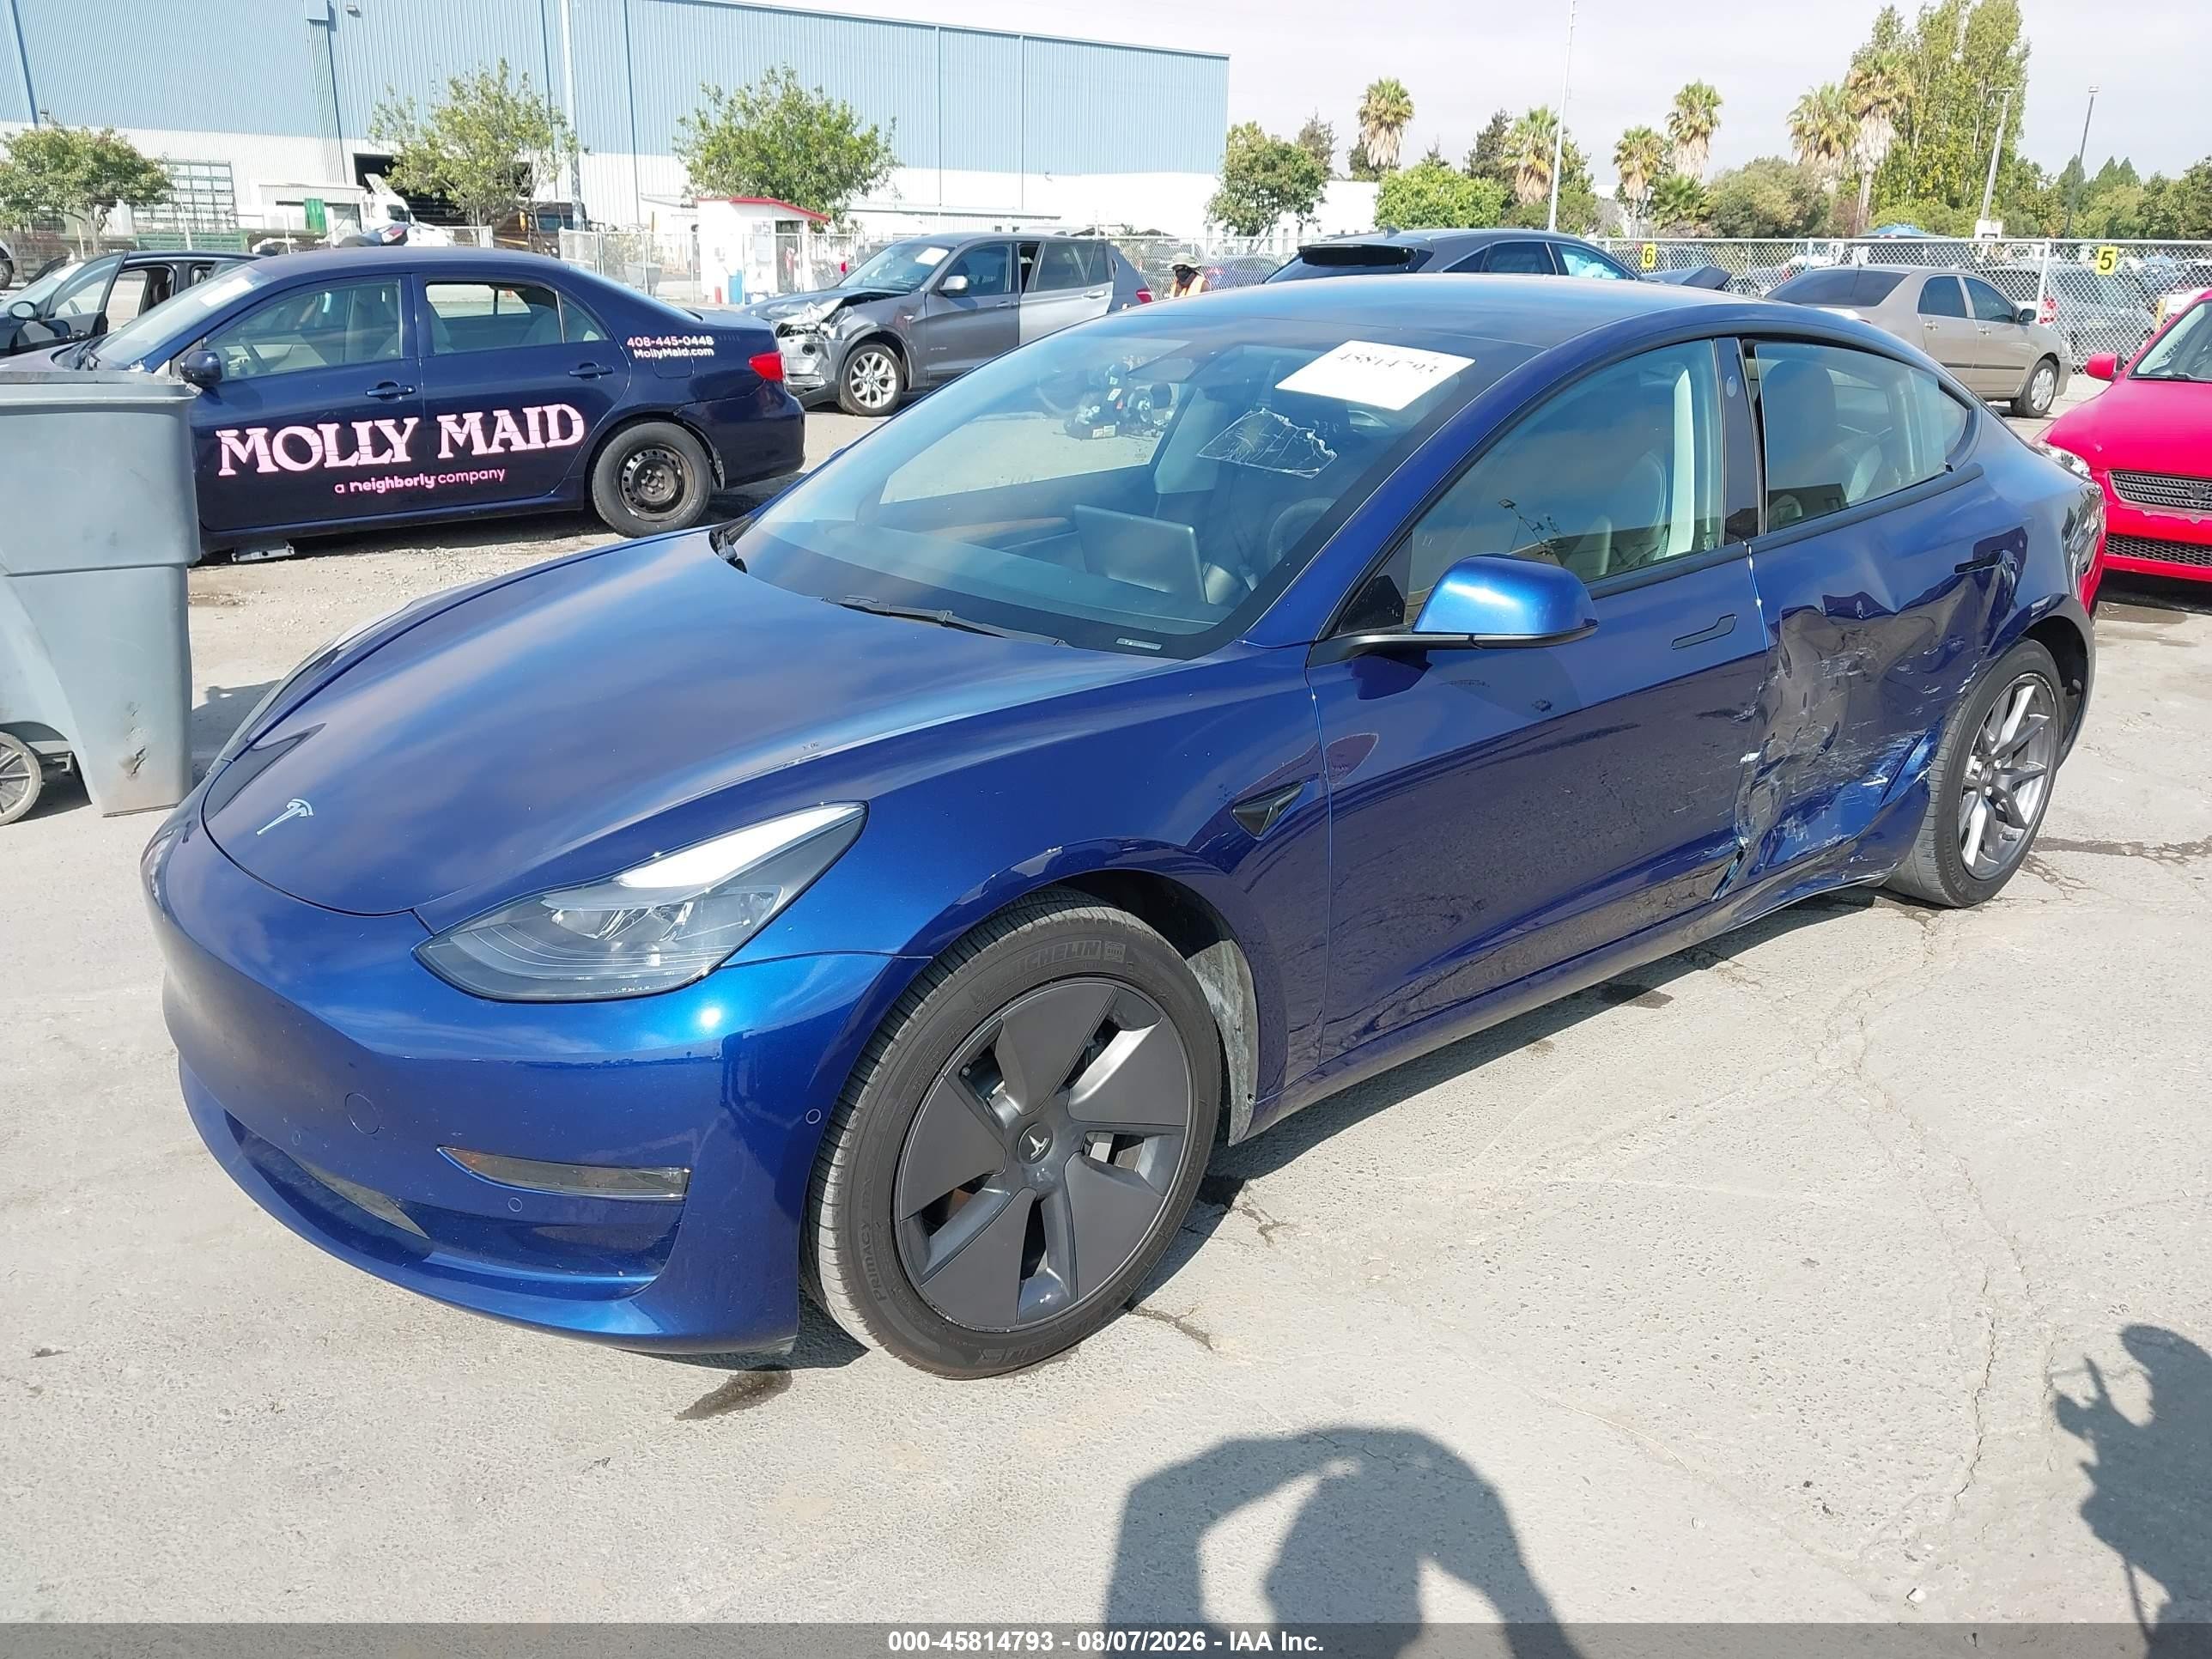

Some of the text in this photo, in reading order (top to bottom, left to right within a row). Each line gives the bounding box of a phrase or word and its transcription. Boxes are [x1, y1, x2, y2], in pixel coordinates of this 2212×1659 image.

[1644, 247, 1654, 264] 6
[2100, 251, 2113, 270] 5
[626, 334, 714, 348] 408-445-0448
[633, 346, 714, 360] MollyMaid.com
[216, 404, 585, 477] MOLLY MAID
[334, 468, 506, 494] a neighborly company
